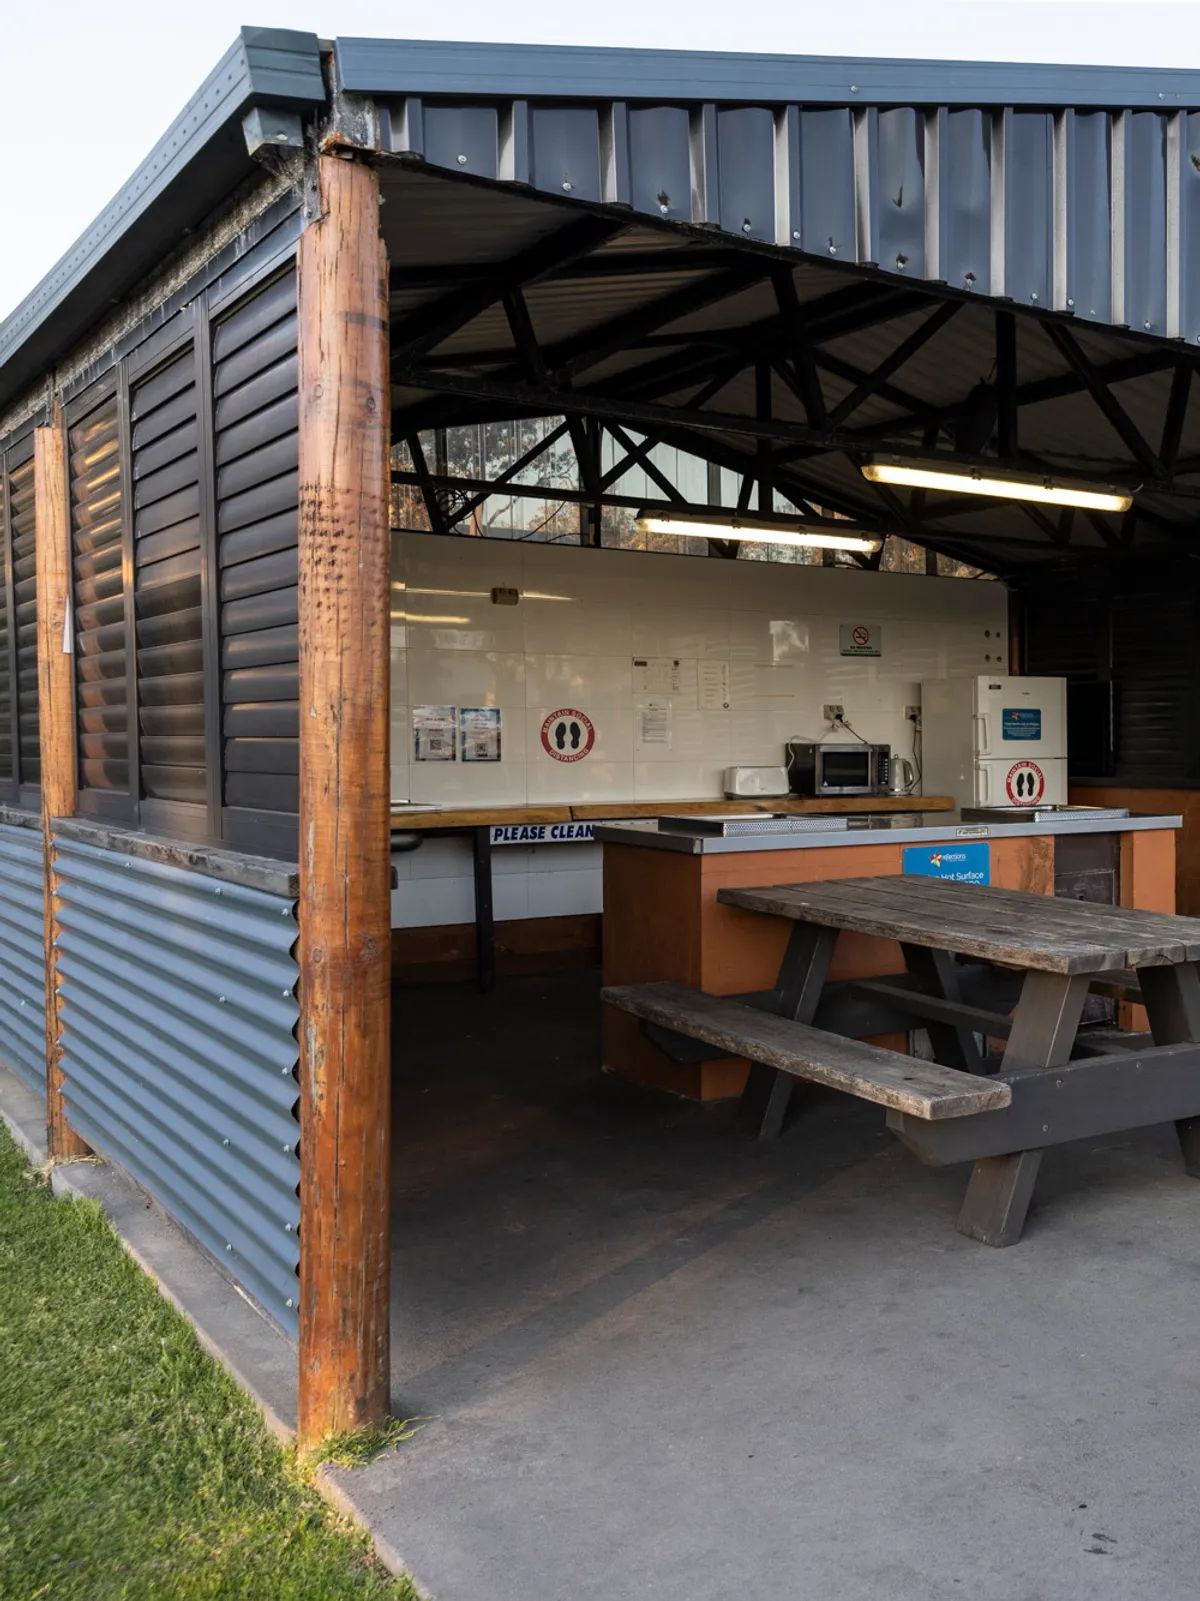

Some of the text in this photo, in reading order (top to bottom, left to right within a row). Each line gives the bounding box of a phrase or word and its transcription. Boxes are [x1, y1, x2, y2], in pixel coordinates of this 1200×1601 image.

[542, 710, 593, 733] MAINTAIN SOCIAL
[549, 749, 590, 762] DISTANCING
[493, 824, 595, 842] PLEASE CLEAN
[956, 871, 985, 881] Surface
